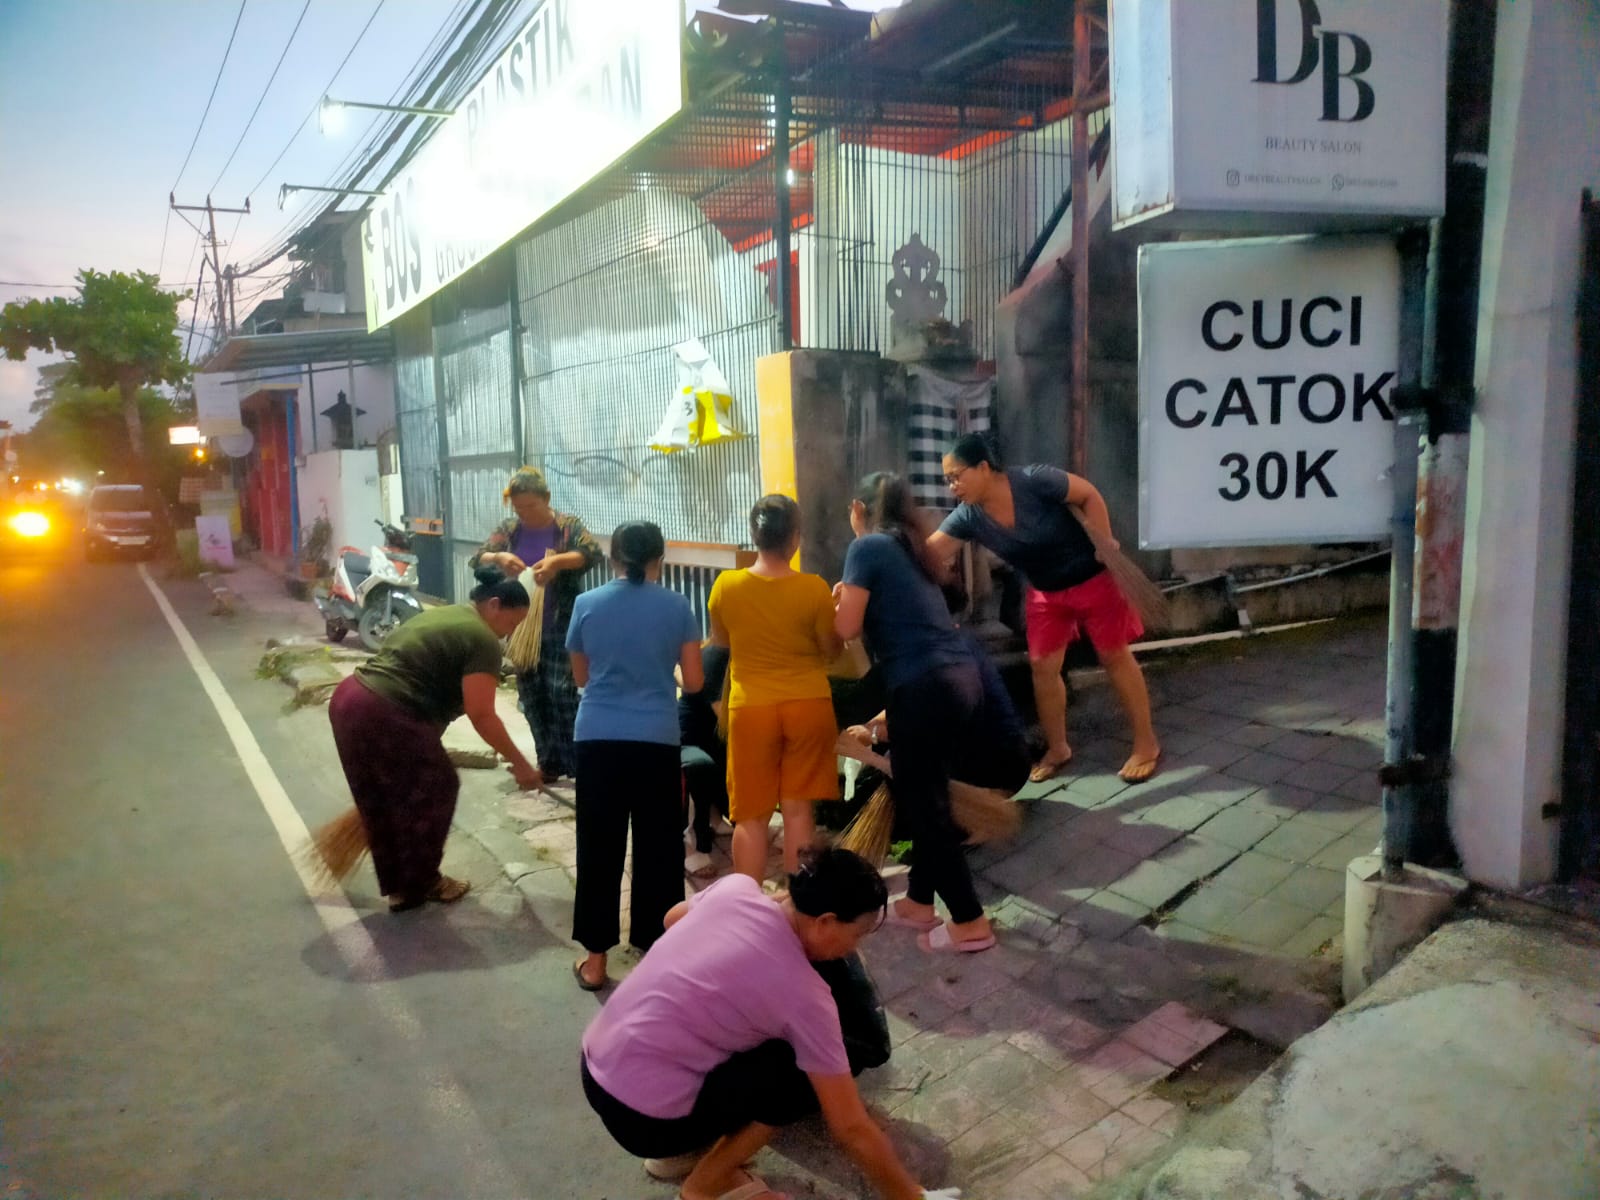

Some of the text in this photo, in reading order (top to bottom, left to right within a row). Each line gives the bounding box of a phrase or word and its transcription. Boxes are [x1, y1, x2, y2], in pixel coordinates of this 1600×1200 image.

[1264, 136, 1362, 154] BEAUTY SALON
[381, 177, 422, 310] BOS
[1201, 295, 1362, 352] CUCI
[1165, 371, 1397, 429] CATOK
[1217, 449, 1339, 502] 30K
